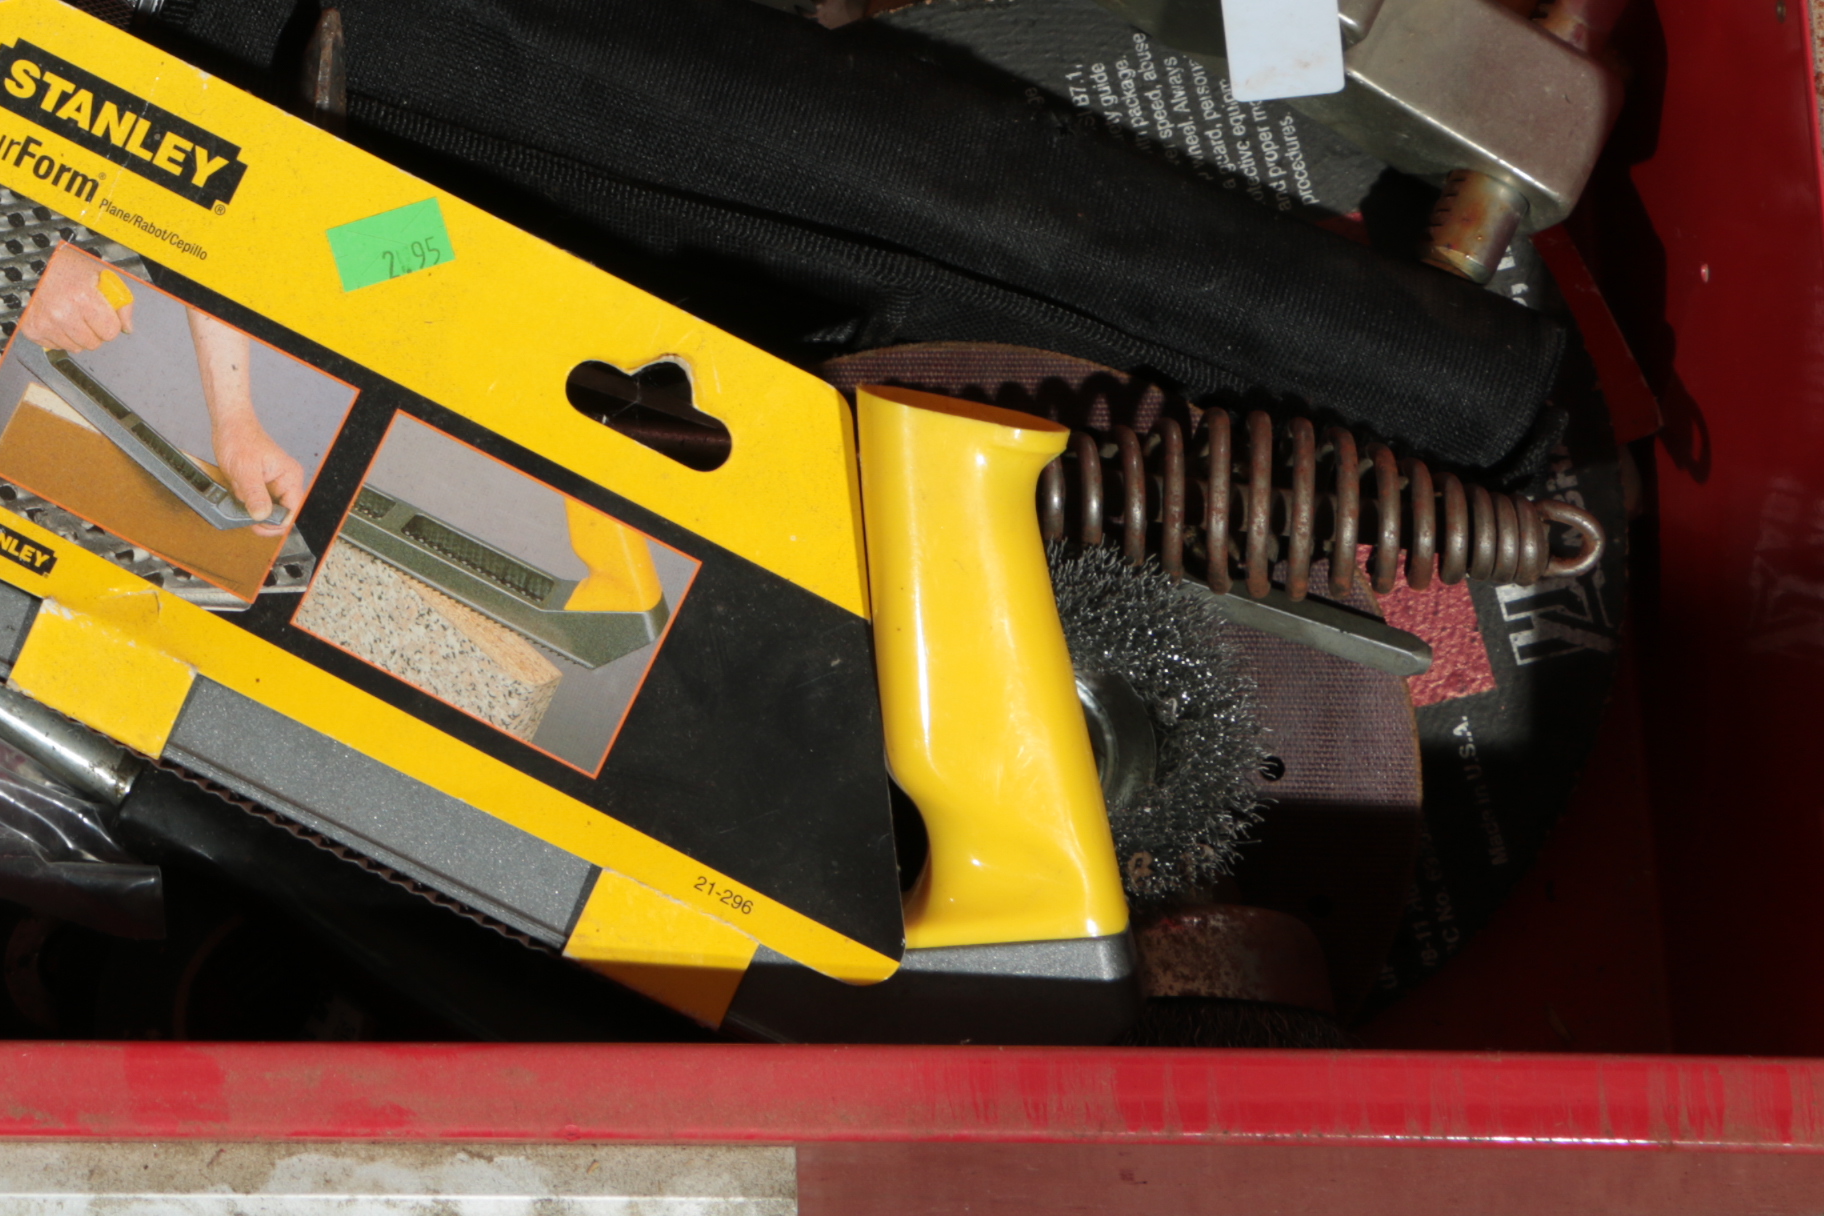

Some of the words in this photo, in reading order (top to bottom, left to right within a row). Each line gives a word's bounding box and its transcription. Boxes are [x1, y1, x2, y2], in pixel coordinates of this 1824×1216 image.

[1090, 62, 1118, 107] guide
[1132, 33, 1157, 81] abuse
[1163, 56, 1191, 113] Always
[1116, 54, 1150, 128] package.
[1144, 84, 1175, 139] speed,
[4, 59, 230, 188] STANLEY
[1204, 123, 1237, 175] guard,
[1256, 126, 1287, 178] proper
[1278, 111, 1320, 205] procedures.
[1268, 179, 1292, 212] and
[98, 198, 208, 261] Plane/Rabot/Cepillo
[1452, 715, 1483, 781] U.S.A.
[1474, 784, 1490, 805] in
[1480, 808, 1509, 865] Made
[693, 876, 754, 915] 21-296
